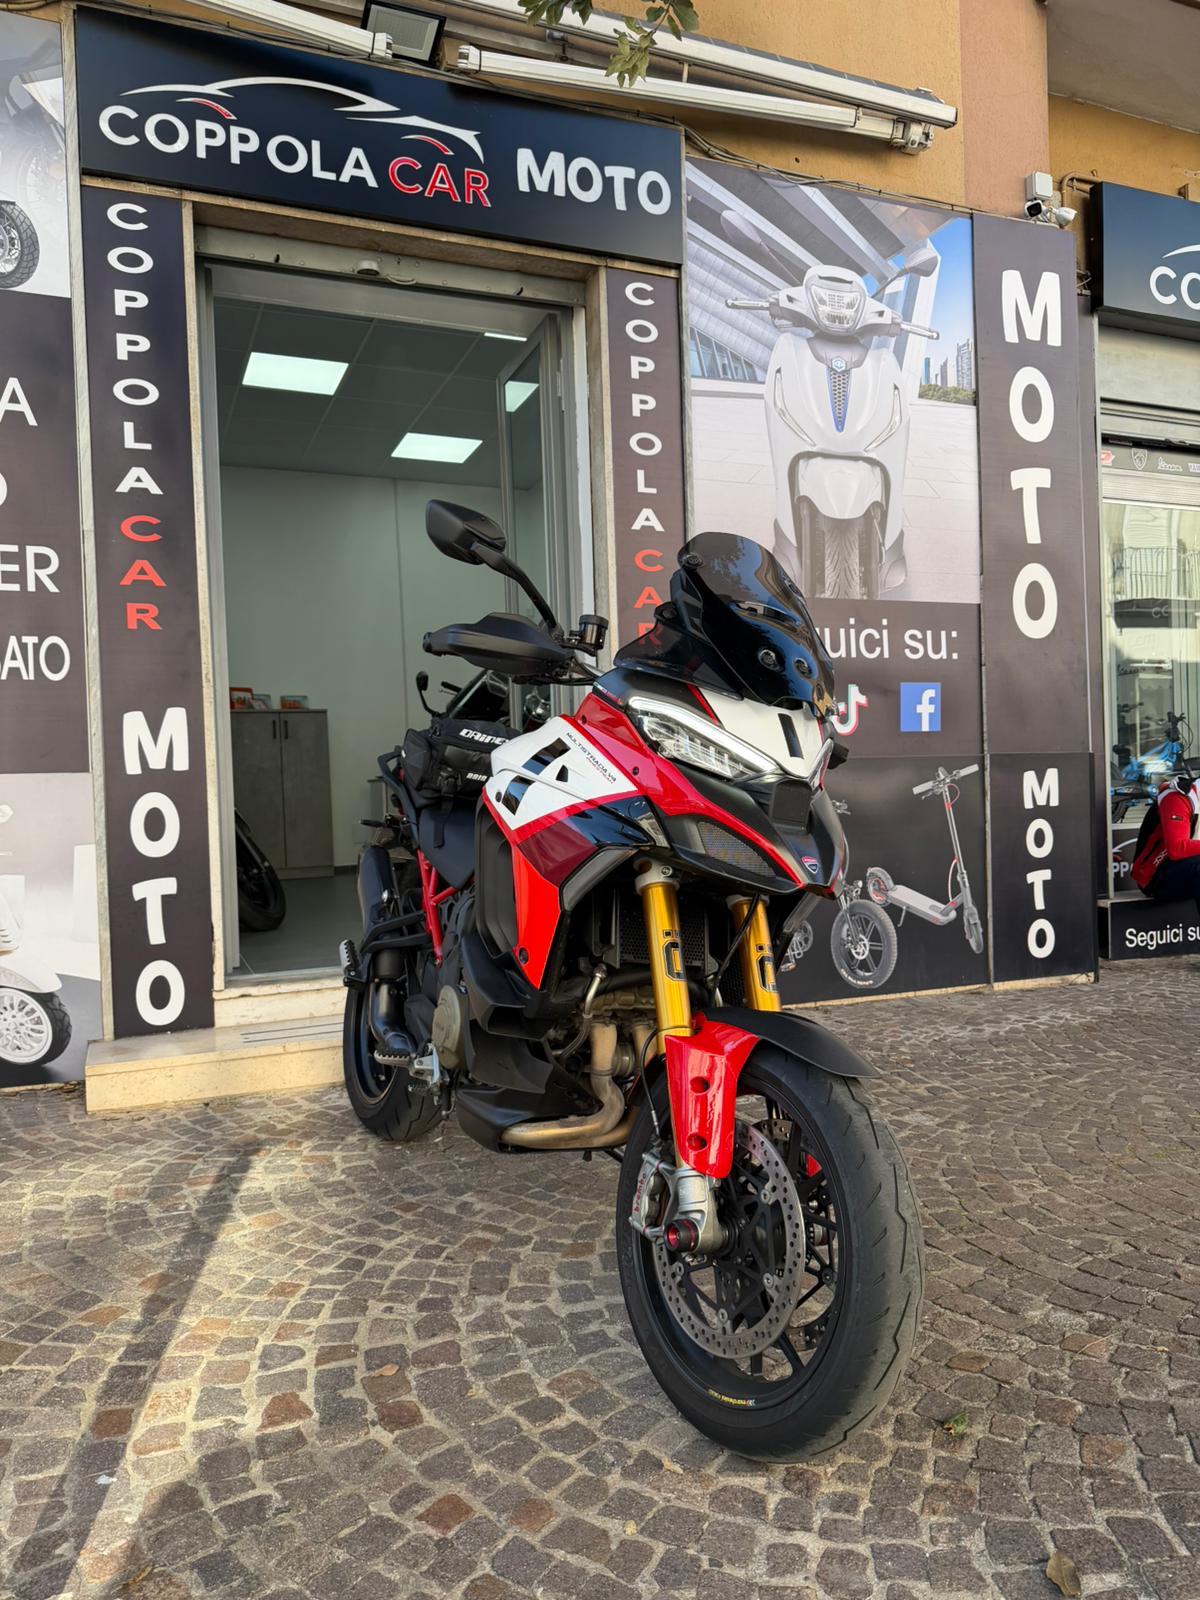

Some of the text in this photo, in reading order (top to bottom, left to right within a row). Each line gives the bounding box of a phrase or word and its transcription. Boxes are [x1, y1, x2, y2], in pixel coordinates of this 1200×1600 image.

[99, 105, 671, 215] COPPOLA CAR MOTO
[0, 377, 38, 426] A
[1002, 270, 1062, 639] MOTO
[0, 544, 60, 593] ER
[0, 635, 71, 682] ATO
[815, 618, 959, 660] uici su:
[123, 707, 189, 1025] MOTO
[1023, 768, 1059, 958] MOTO
[1125, 924, 1183, 950] Seguici
